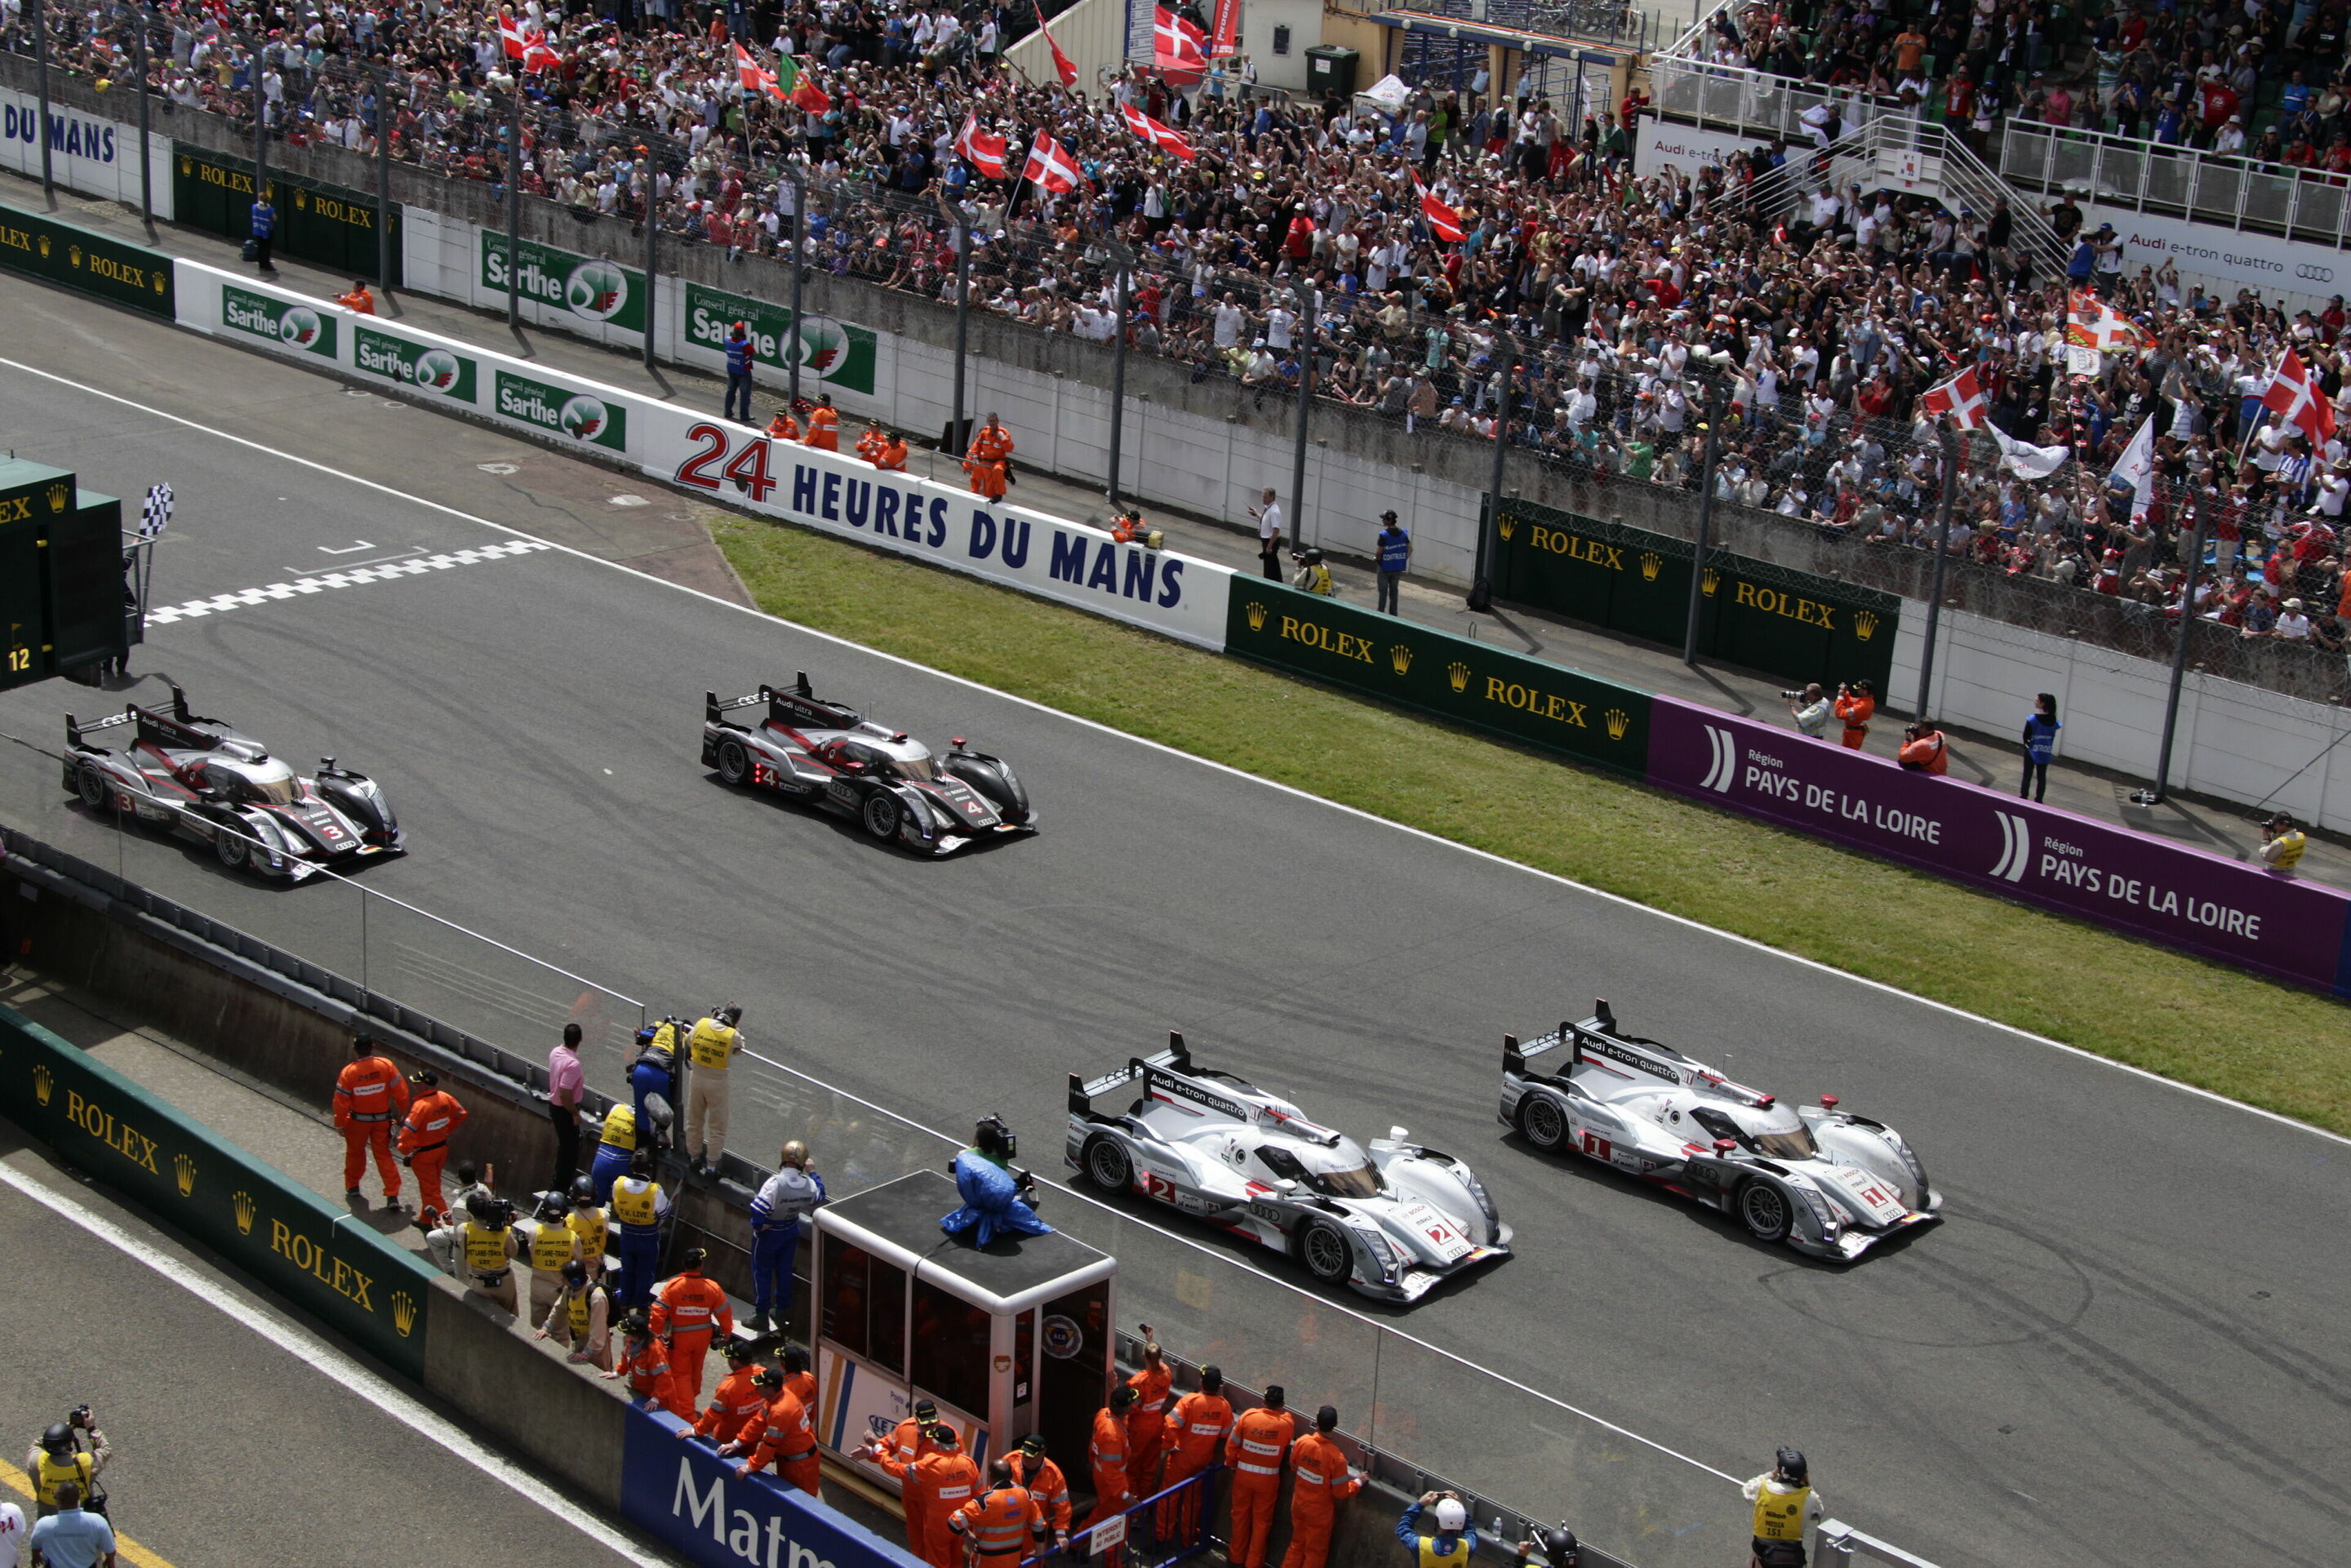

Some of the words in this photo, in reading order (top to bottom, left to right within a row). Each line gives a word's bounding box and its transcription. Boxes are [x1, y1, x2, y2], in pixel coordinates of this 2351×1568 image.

[5, 104, 35, 144] DU
[49, 113, 114, 162] MANS
[1655, 140, 1685, 155] Audi
[200, 163, 255, 194] ROLEX
[315, 197, 371, 229] ROLEX
[0, 225, 31, 251] LEX
[487, 239, 511, 256] Conse
[2129, 233, 2166, 250] Audi
[2171, 242, 2219, 260] e-tron
[2223, 252, 2284, 273] quattro
[90, 254, 145, 288] ROLEX
[228, 290, 247, 304] Conseil
[694, 292, 726, 313] Conseil
[727, 303, 760, 322] général
[227, 301, 278, 336] Sarthe
[359, 332, 380, 348] Conseil
[692, 308, 776, 358] Sarhe
[359, 344, 413, 379] Sarthe
[500, 376, 523, 392] Conseil
[500, 387, 558, 425] Sarthe
[0, 496, 32, 523] EX
[673, 421, 777, 503] 24
[793, 464, 949, 549] HEURES
[969, 509, 1031, 569] DU
[1049, 530, 1184, 609] MANS
[1530, 525, 1624, 571] ROLEX
[1735, 581, 1836, 630] ROLEX
[1280, 615, 1375, 664] ROLEX
[9, 648, 30, 672] 12
[776, 696, 793, 710] Audi
[793, 703, 813, 717] ultra
[1484, 676, 1588, 728] ROLEX
[141, 715, 159, 730] Audi
[159, 723, 177, 736] ultra
[1748, 748, 1784, 770] Région
[762, 769, 776, 786] 4
[119, 794, 132, 812] 3
[967, 801, 983, 815] 4
[1745, 766, 1800, 802] PAYS
[1806, 784, 1834, 814] DE
[1841, 797, 1869, 825] LA
[1875, 808, 1942, 846] LOIRE
[323, 824, 344, 840] 3
[2044, 836, 2084, 858] Région
[2040, 854, 2101, 891] PAYS
[2109, 875, 2141, 905] DE
[2147, 886, 2179, 917] LA
[2186, 899, 2262, 941] LOIRE
[1581, 1036, 1606, 1052] Audi
[1607, 1047, 1638, 1064] e-tron
[1640, 1059, 1678, 1080] quattro
[1682, 1068, 1694, 1085] HY
[1151, 1073, 1174, 1089] Audi
[1176, 1084, 1206, 1102] e-tron
[1208, 1095, 1245, 1117] quattro
[1249, 1104, 1260, 1121] HY
[66, 1089, 159, 1175] ROLEX
[1590, 1137, 1604, 1158] 1
[1153, 1178, 1171, 1201] 2
[1863, 1188, 1887, 1207] 1
[1207, 1202, 1219, 1211] P1
[1429, 1225, 1455, 1246] 2
[270, 1217, 375, 1313] ROLEX
[541, 1250, 569, 1258] LANE-TRACK
[873, 1416, 888, 1435] LE
[1249, 1443, 1278, 1453] DUNLOP
[1766, 1510, 1787, 1519] Nikon
[1096, 1521, 1123, 1539] INTERDIT
[1104, 1530, 1122, 1544] PUBLIC
[1767, 1527, 1781, 1536] 151
